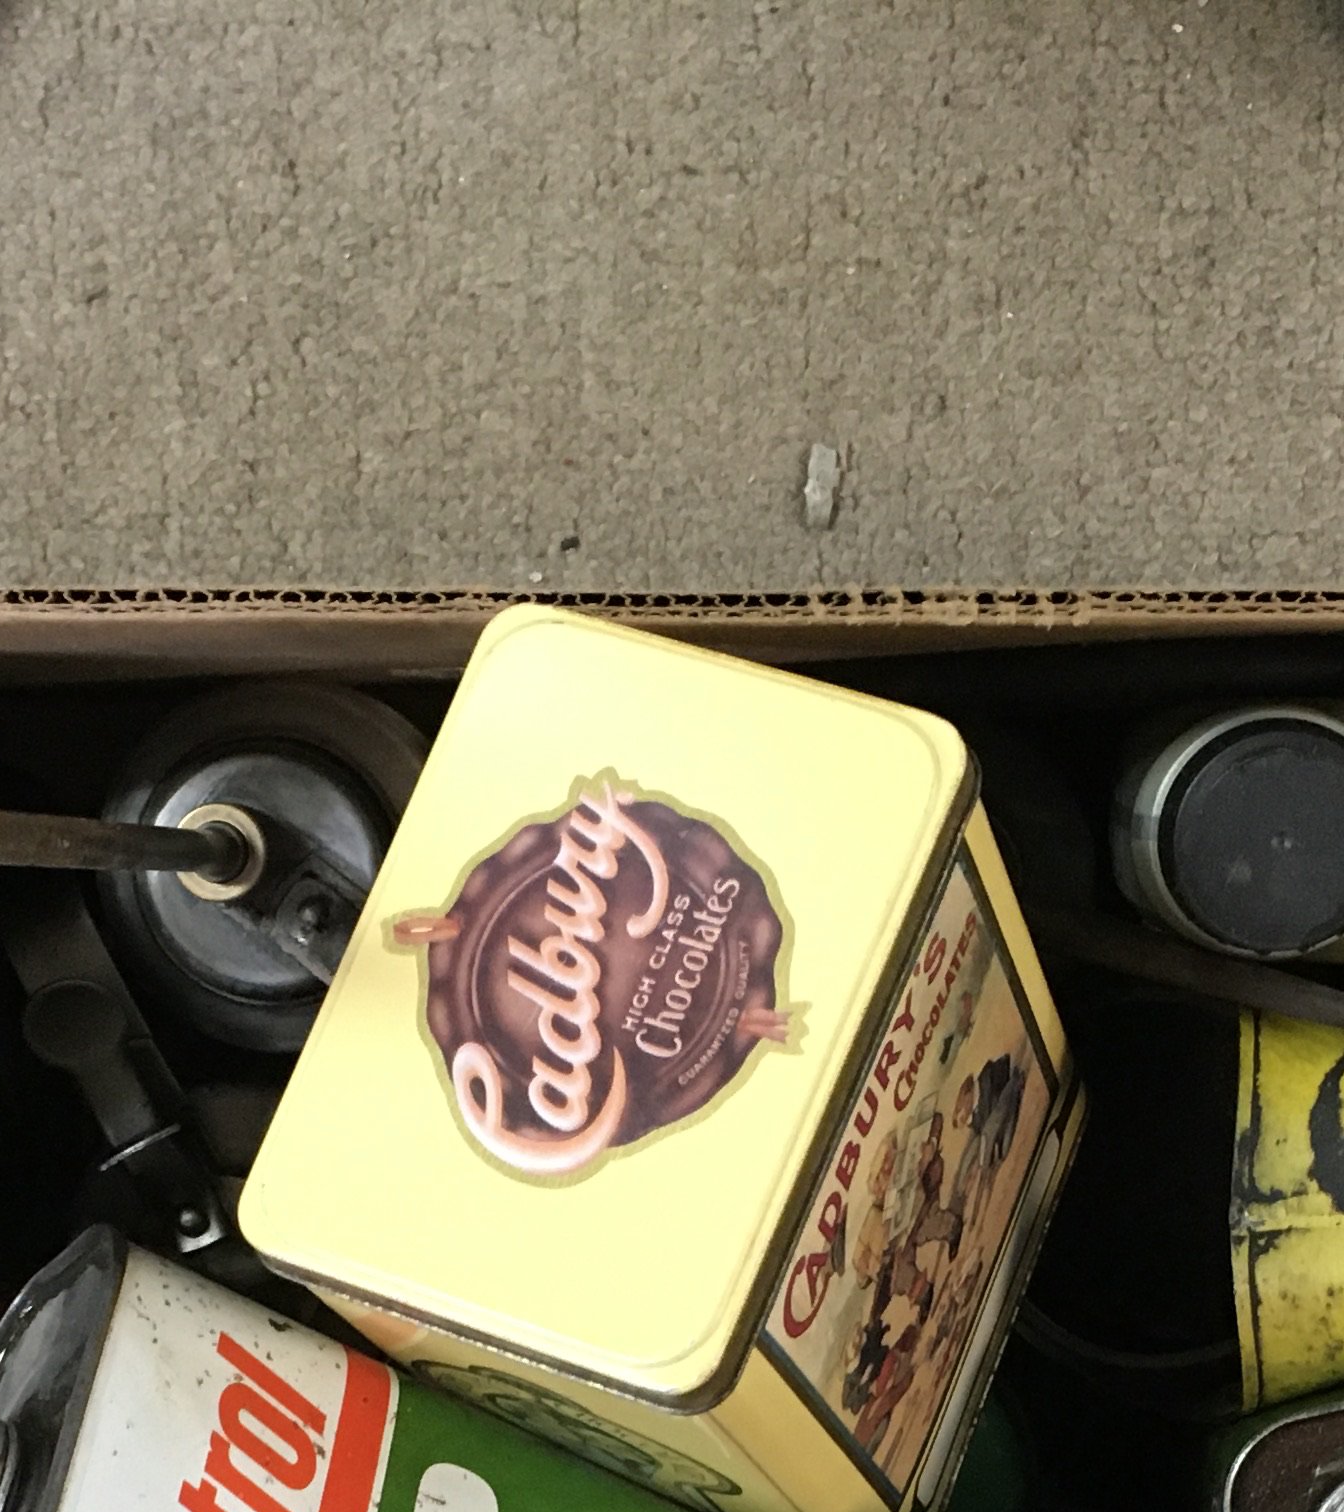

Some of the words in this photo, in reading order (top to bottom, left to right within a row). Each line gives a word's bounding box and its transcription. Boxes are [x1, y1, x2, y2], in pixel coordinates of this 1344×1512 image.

[452, 779, 669, 1175] Cadbury
[621, 976, 656, 1032] HIGH
[649, 893, 691, 970] CLASS
[635, 877, 741, 1058] Chocolates
[734, 940, 750, 1000] QUALITY
[893, 912, 977, 1112] CHOCOLATES
[783, 931, 947, 1338] CADBURY'S
